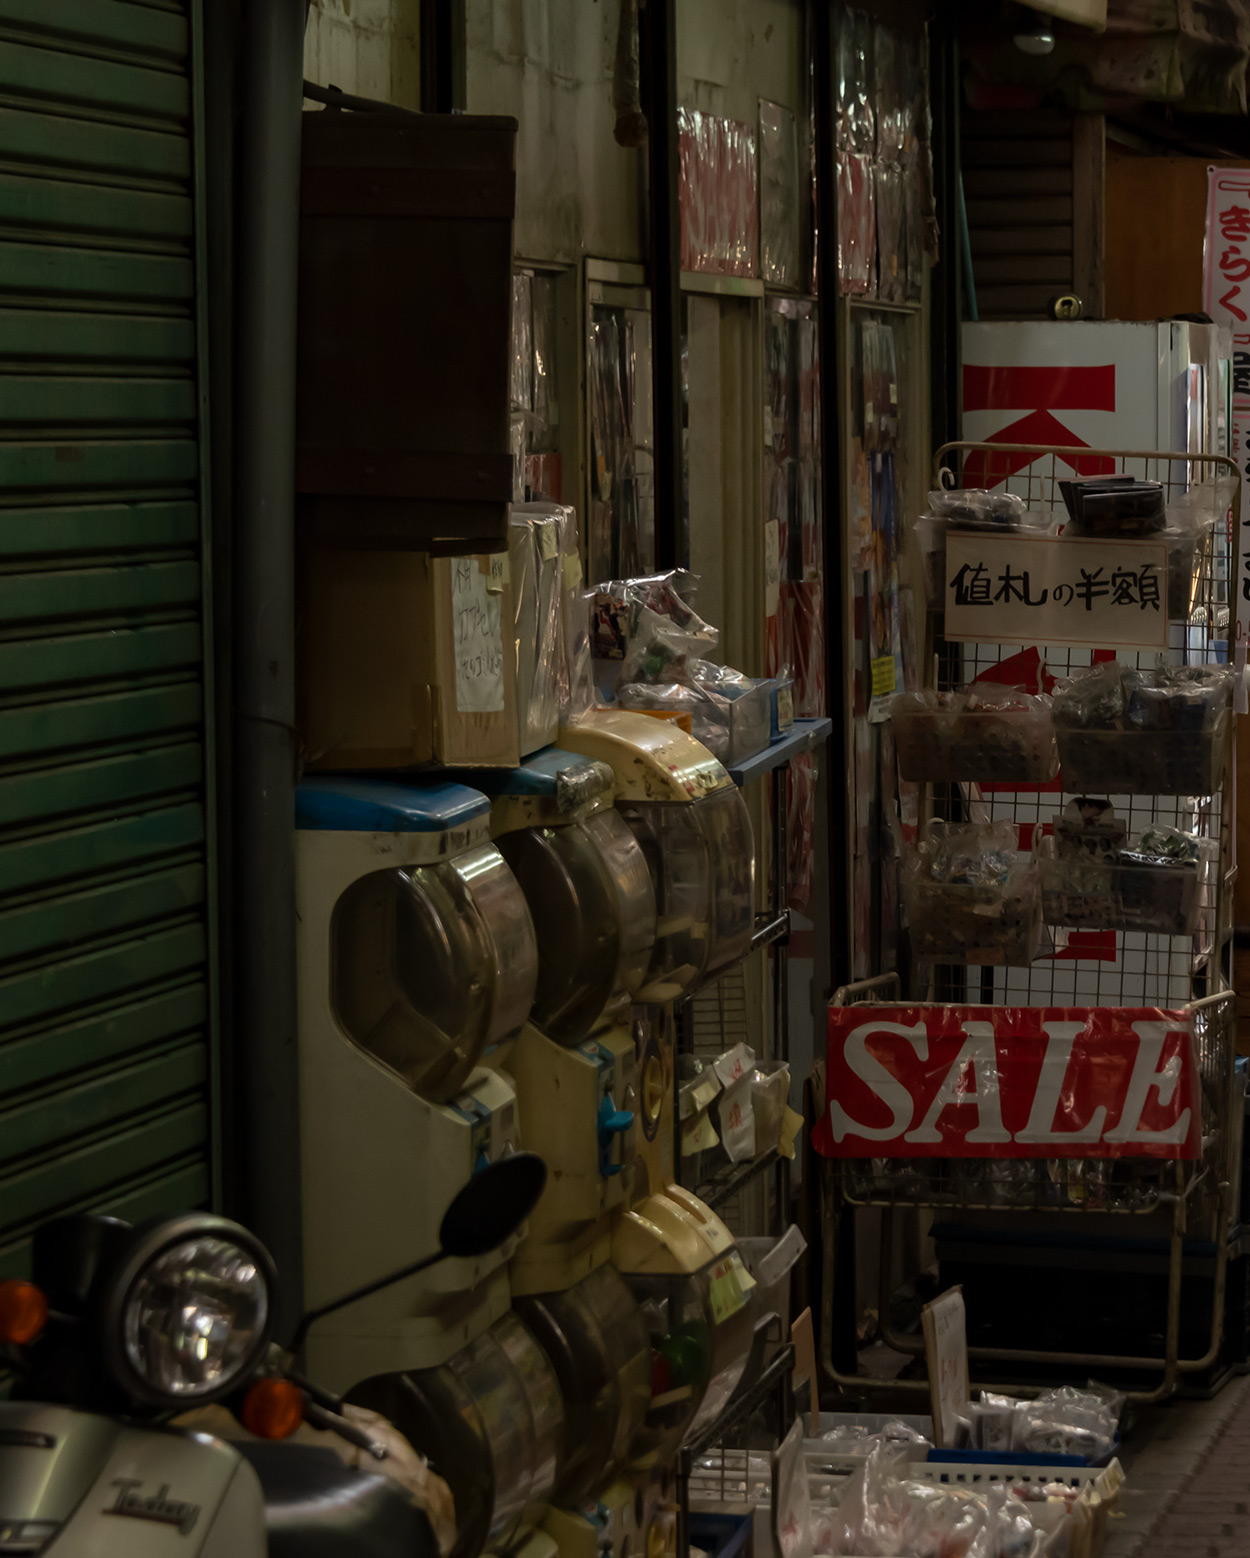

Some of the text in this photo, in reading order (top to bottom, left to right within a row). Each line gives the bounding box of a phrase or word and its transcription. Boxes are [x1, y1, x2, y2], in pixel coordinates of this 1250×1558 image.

[950, 562, 1160, 612] 値札の半額
[829, 1019, 1193, 1145] SALE
